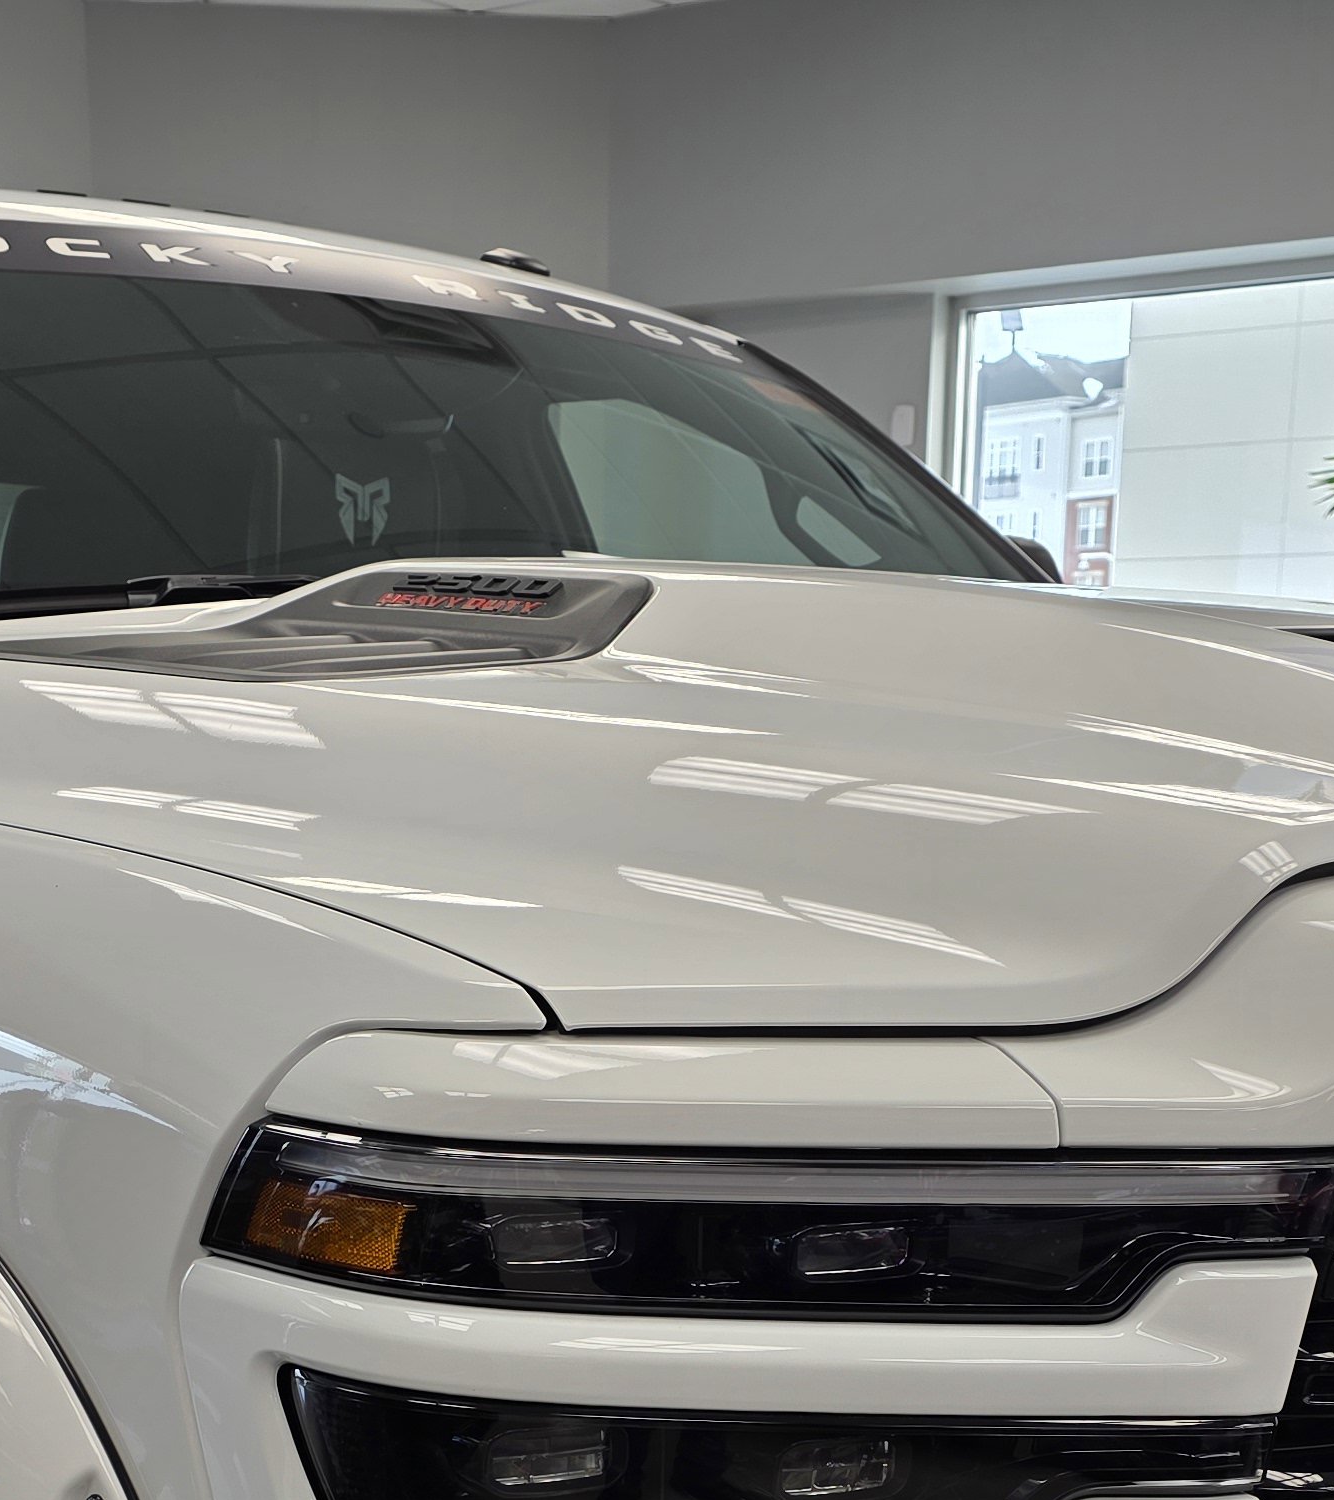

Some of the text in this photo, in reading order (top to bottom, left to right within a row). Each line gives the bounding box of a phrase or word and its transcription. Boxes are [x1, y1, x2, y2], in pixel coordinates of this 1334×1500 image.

[411, 274, 744, 364] RIDGE
[392, 573, 565, 599] 2500
[375, 592, 547, 615] HEAVY DUTY
